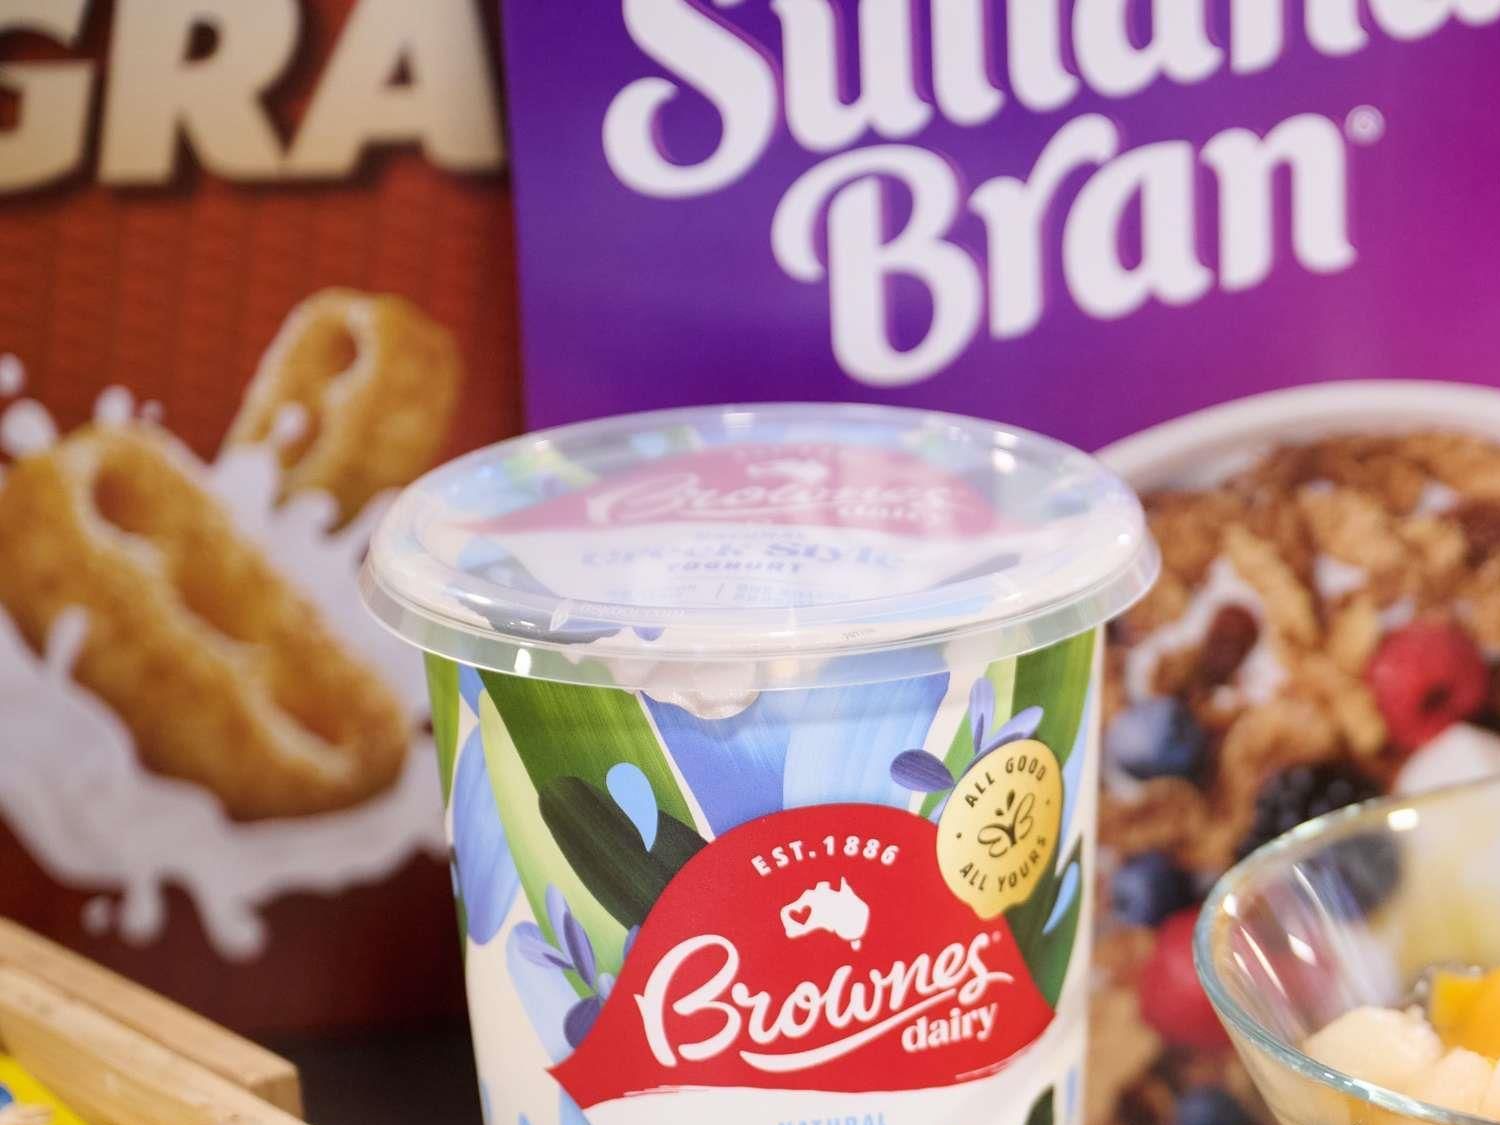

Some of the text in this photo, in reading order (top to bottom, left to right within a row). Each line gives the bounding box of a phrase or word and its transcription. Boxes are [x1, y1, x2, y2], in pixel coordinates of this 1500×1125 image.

[771, 113, 1356, 385] Bran
[965, 755, 1048, 808] ALL GOOD
[959, 835, 1047, 892] ALL YOURS
[633, 932, 1014, 1072] Brownes
[902, 1002, 998, 1053] dairy
